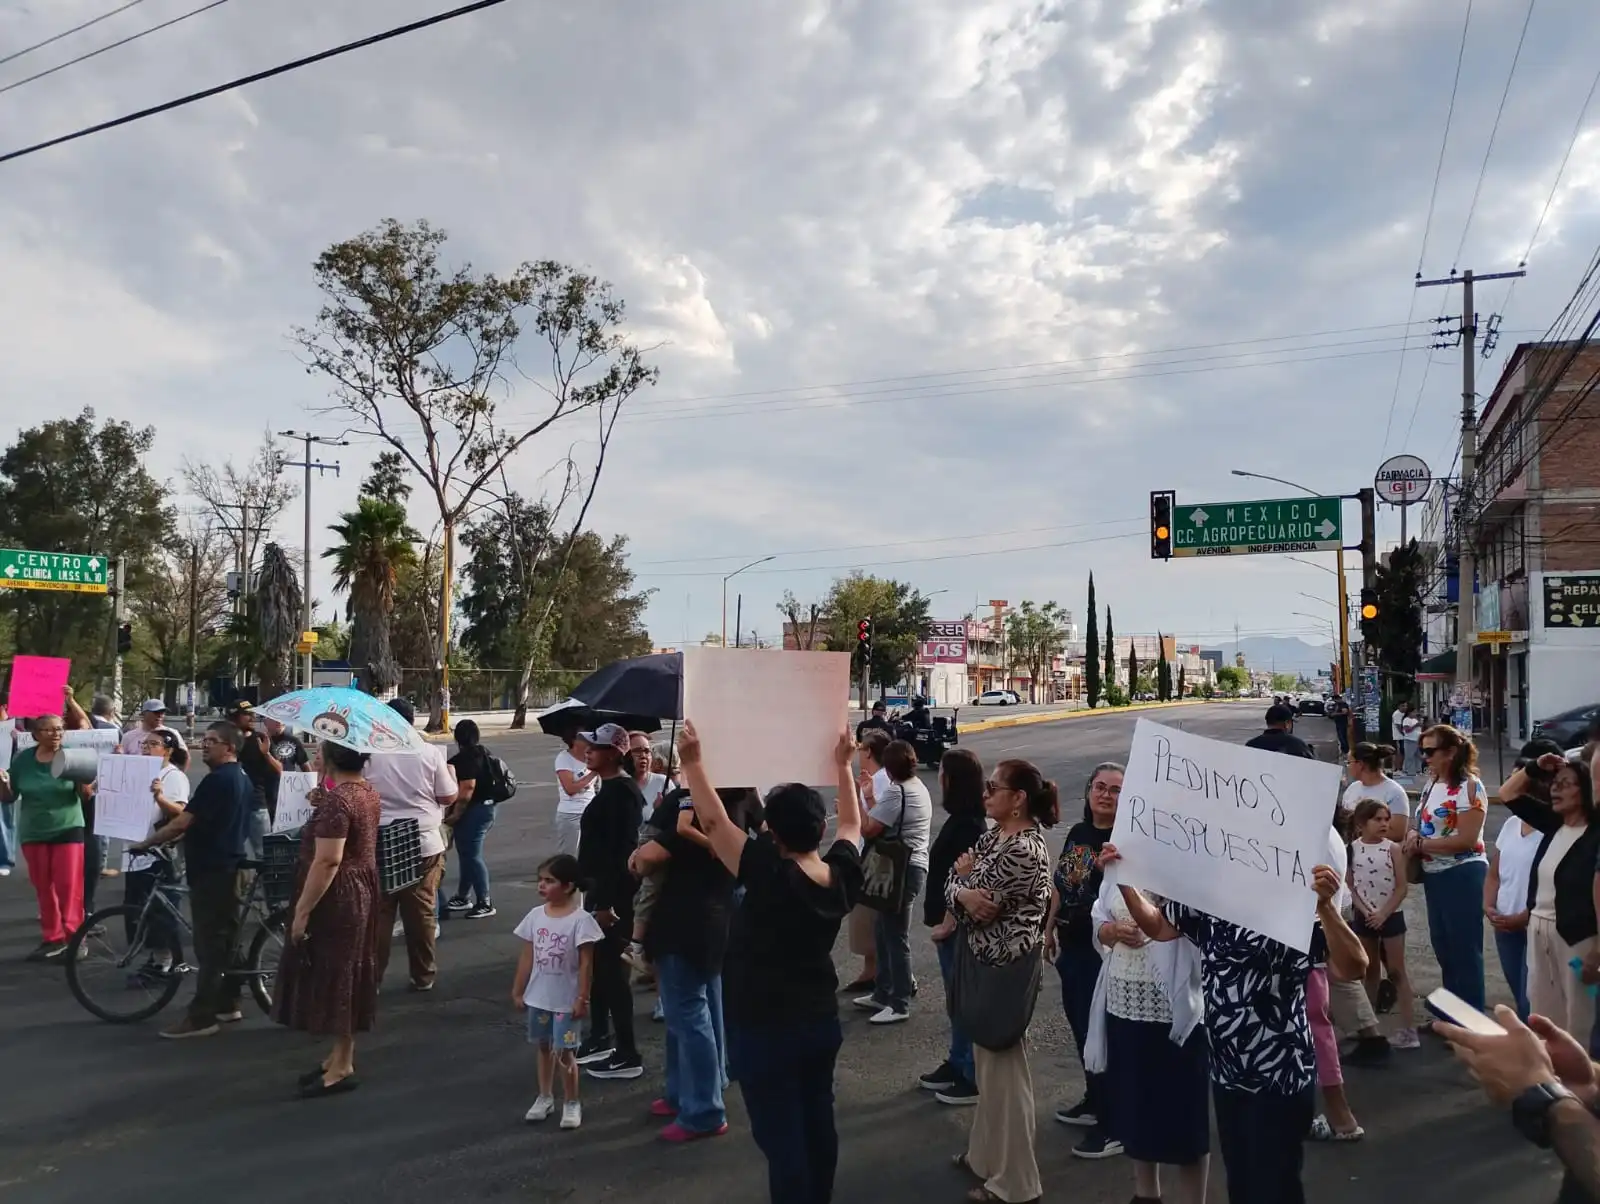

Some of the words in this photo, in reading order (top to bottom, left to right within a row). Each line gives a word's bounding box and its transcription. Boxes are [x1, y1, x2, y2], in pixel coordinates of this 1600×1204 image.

[1226, 503, 1317, 523] MEXICO
[1203, 521, 1312, 543] AGROPECUARIO
[1196, 545, 1231, 555] AVENIDA
[1248, 541, 1317, 553] INDEPENDENCIA
[18, 553, 81, 569] CENTRO
[1563, 585, 1600, 596] REPA
[1152, 734, 1285, 827] PEDIMOS
[1129, 794, 1307, 887] RESPUESTA
